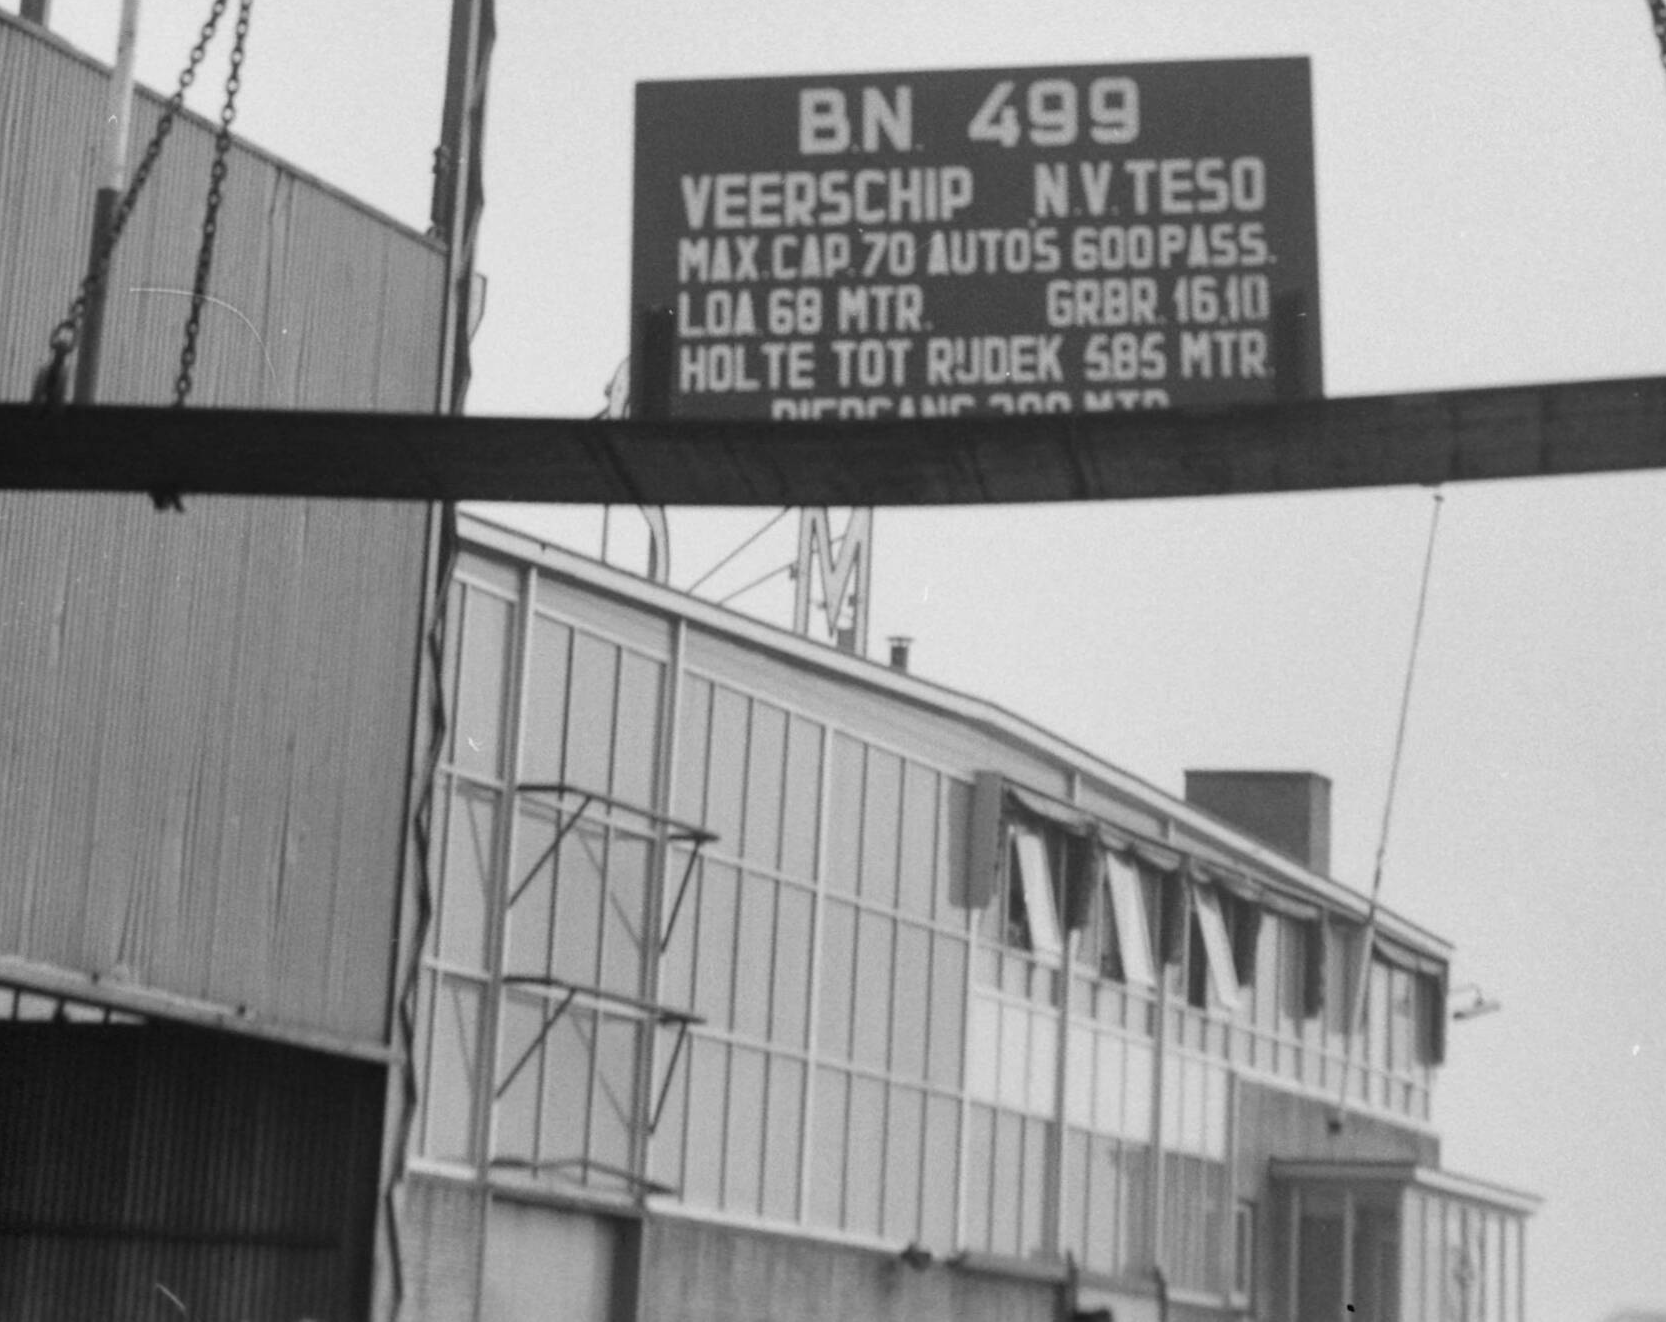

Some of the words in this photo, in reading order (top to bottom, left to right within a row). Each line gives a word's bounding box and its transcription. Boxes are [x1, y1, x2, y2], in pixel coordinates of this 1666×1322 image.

[968, 77, 1141, 147] 499
[682, 166, 974, 229] VEERSCHIP
[1123, 156, 1265, 215] TESO
[861, 231, 915, 278] 70
[1072, 225, 1154, 271] 600
[768, 287, 823, 335] 68
[838, 283, 933, 333] MTR.
[1173, 273, 1270, 324] 16.10
[679, 340, 816, 393] HOLTE
[831, 338, 913, 388] TOT
